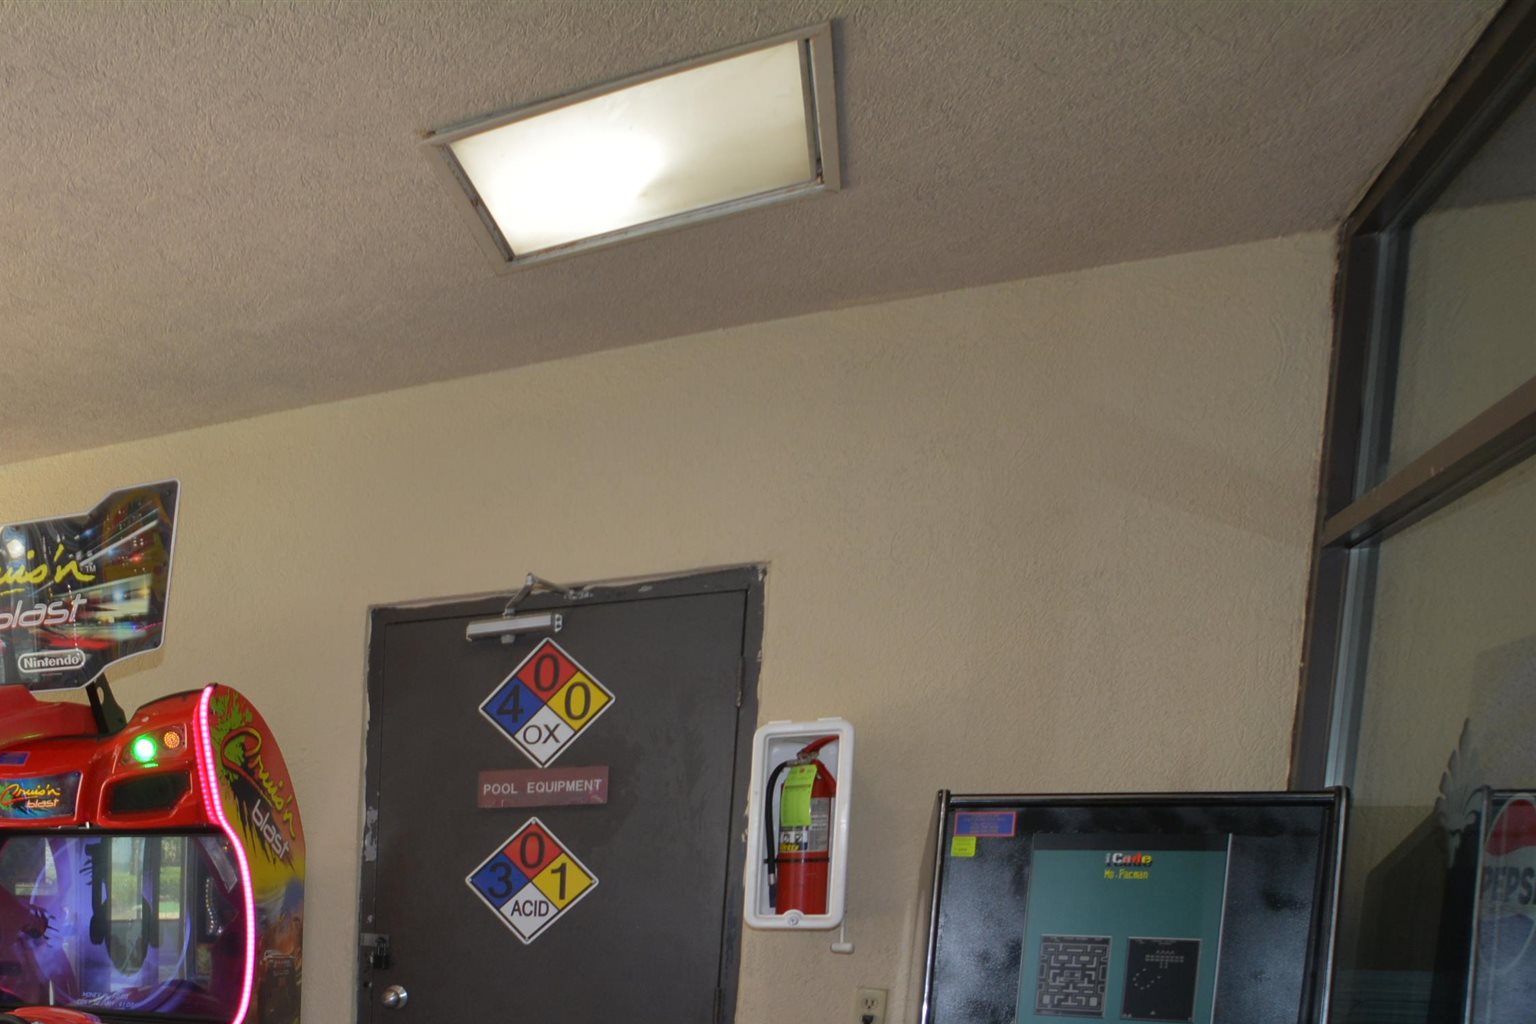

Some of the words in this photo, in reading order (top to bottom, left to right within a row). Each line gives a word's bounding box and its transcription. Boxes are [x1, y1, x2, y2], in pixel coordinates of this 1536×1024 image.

[23, 653, 80, 669] Nintendo
[534, 653, 560, 692] 0
[497, 685, 524, 723] 4
[564, 682, 591, 720] 0
[522, 724, 561, 744] OX
[27, 798, 60, 809] blast
[483, 782, 517, 795] POOL
[527, 779, 602, 794] EQUIPMENT
[251, 798, 290, 859] blast
[519, 832, 545, 868] 0
[487, 861, 513, 899] 3
[551, 863, 567, 900] 1
[1483, 866, 1536, 906] PEPS
[511, 900, 550, 917] ACID
